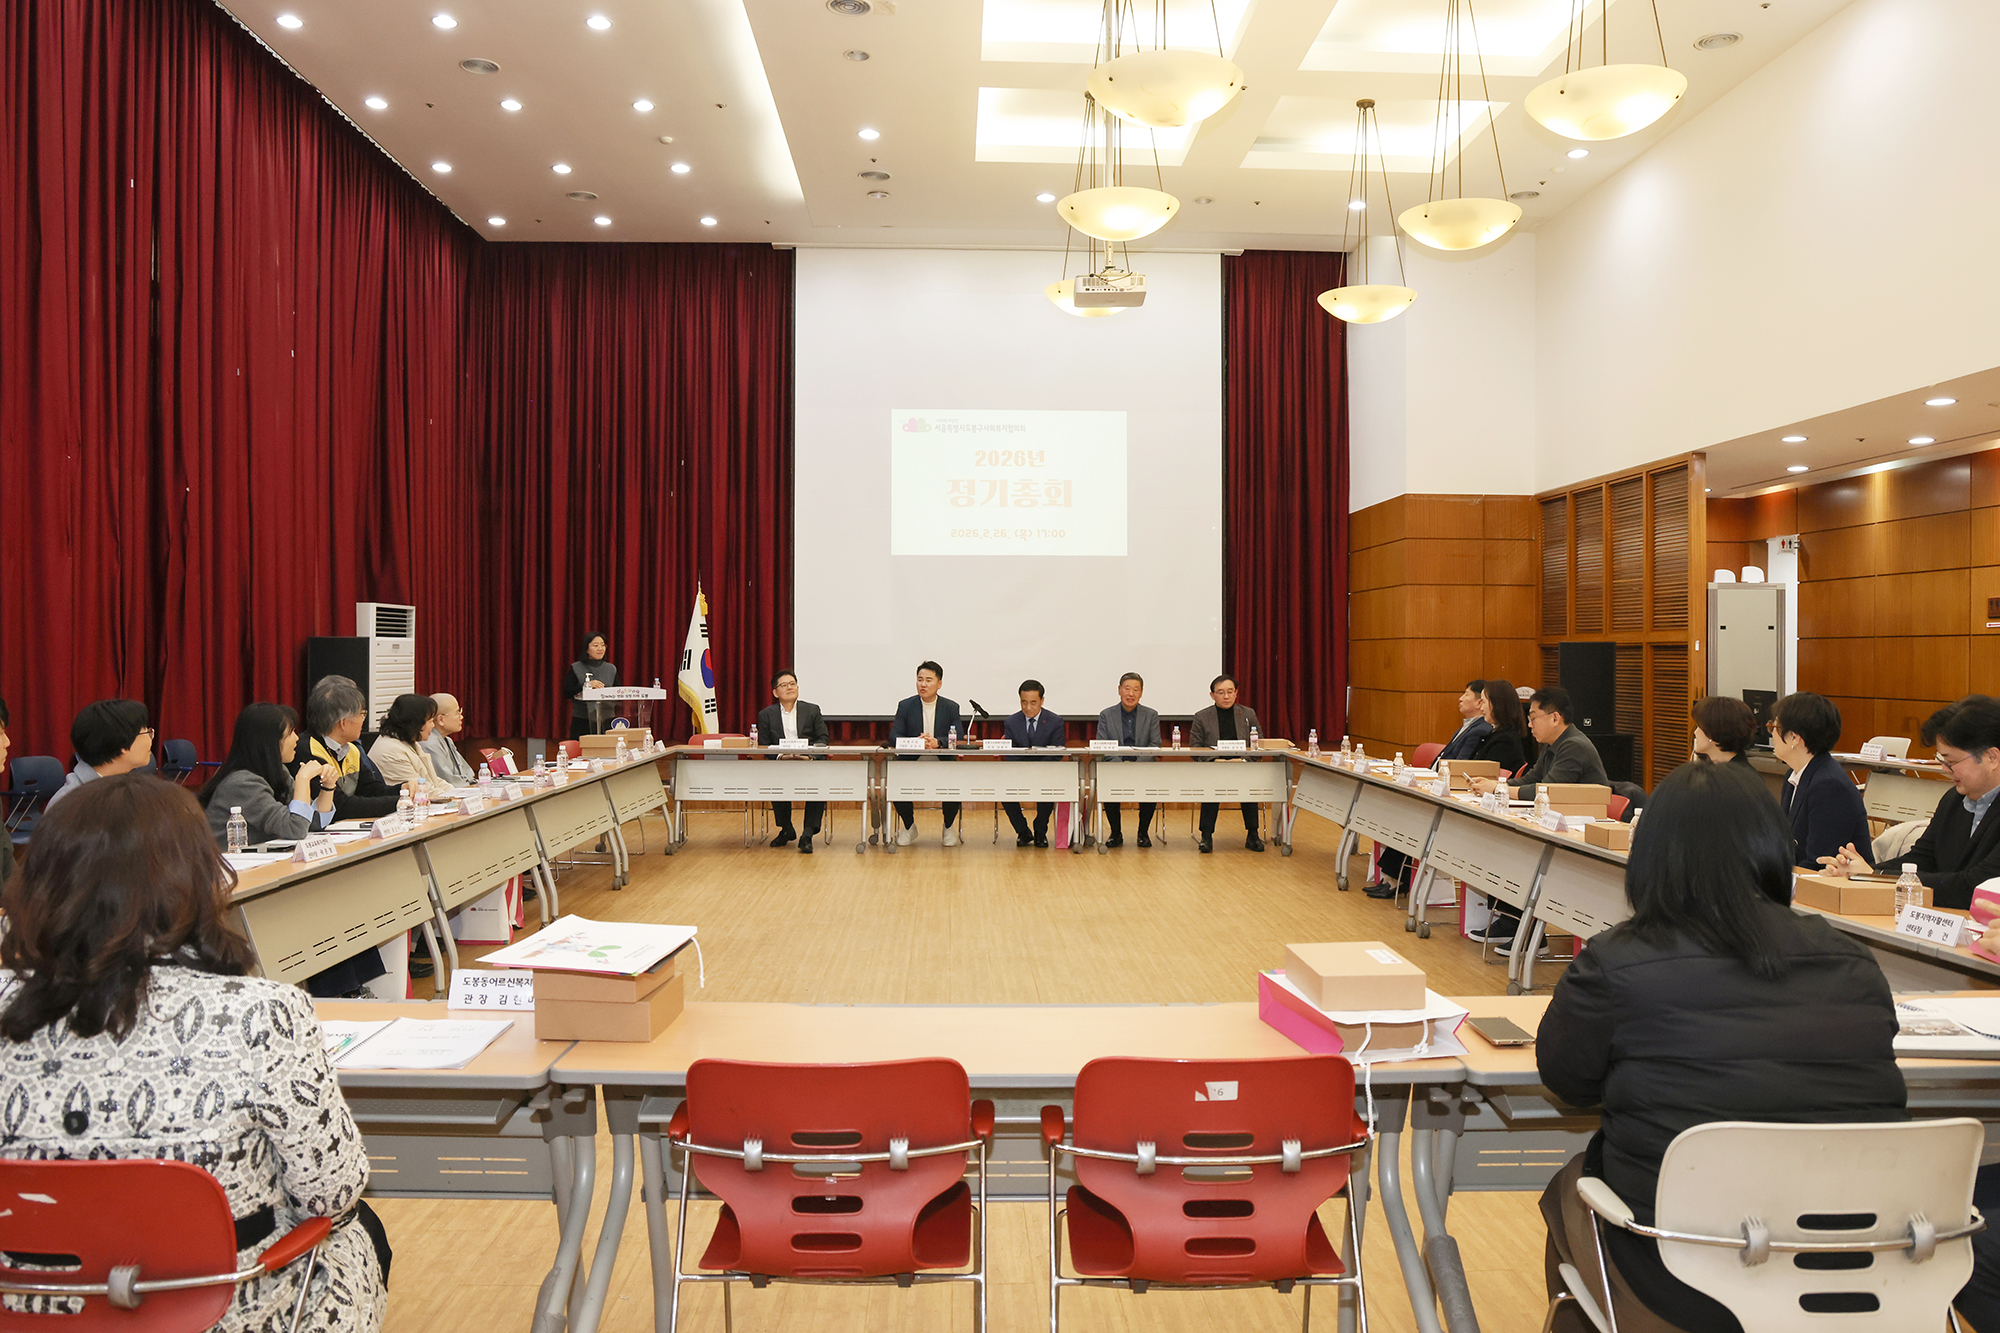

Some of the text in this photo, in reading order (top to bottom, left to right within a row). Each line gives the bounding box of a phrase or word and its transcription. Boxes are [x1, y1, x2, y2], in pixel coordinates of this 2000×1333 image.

[934, 423, 1026, 433] 서울특별시도봉구사회복지협의회
[974, 449, 1046, 468] 2026년
[946, 478, 1073, 508] 정기총회
[950, 528, 1066, 541] 2026.2.26. (목) 17:00
[1909, 910, 1955, 928] 도봉지역자활센터
[1905, 923, 1923, 935] 센터장
[1941, 932, 1949, 942] 건
[462, 977, 533, 988] 도봉동어르신복지
